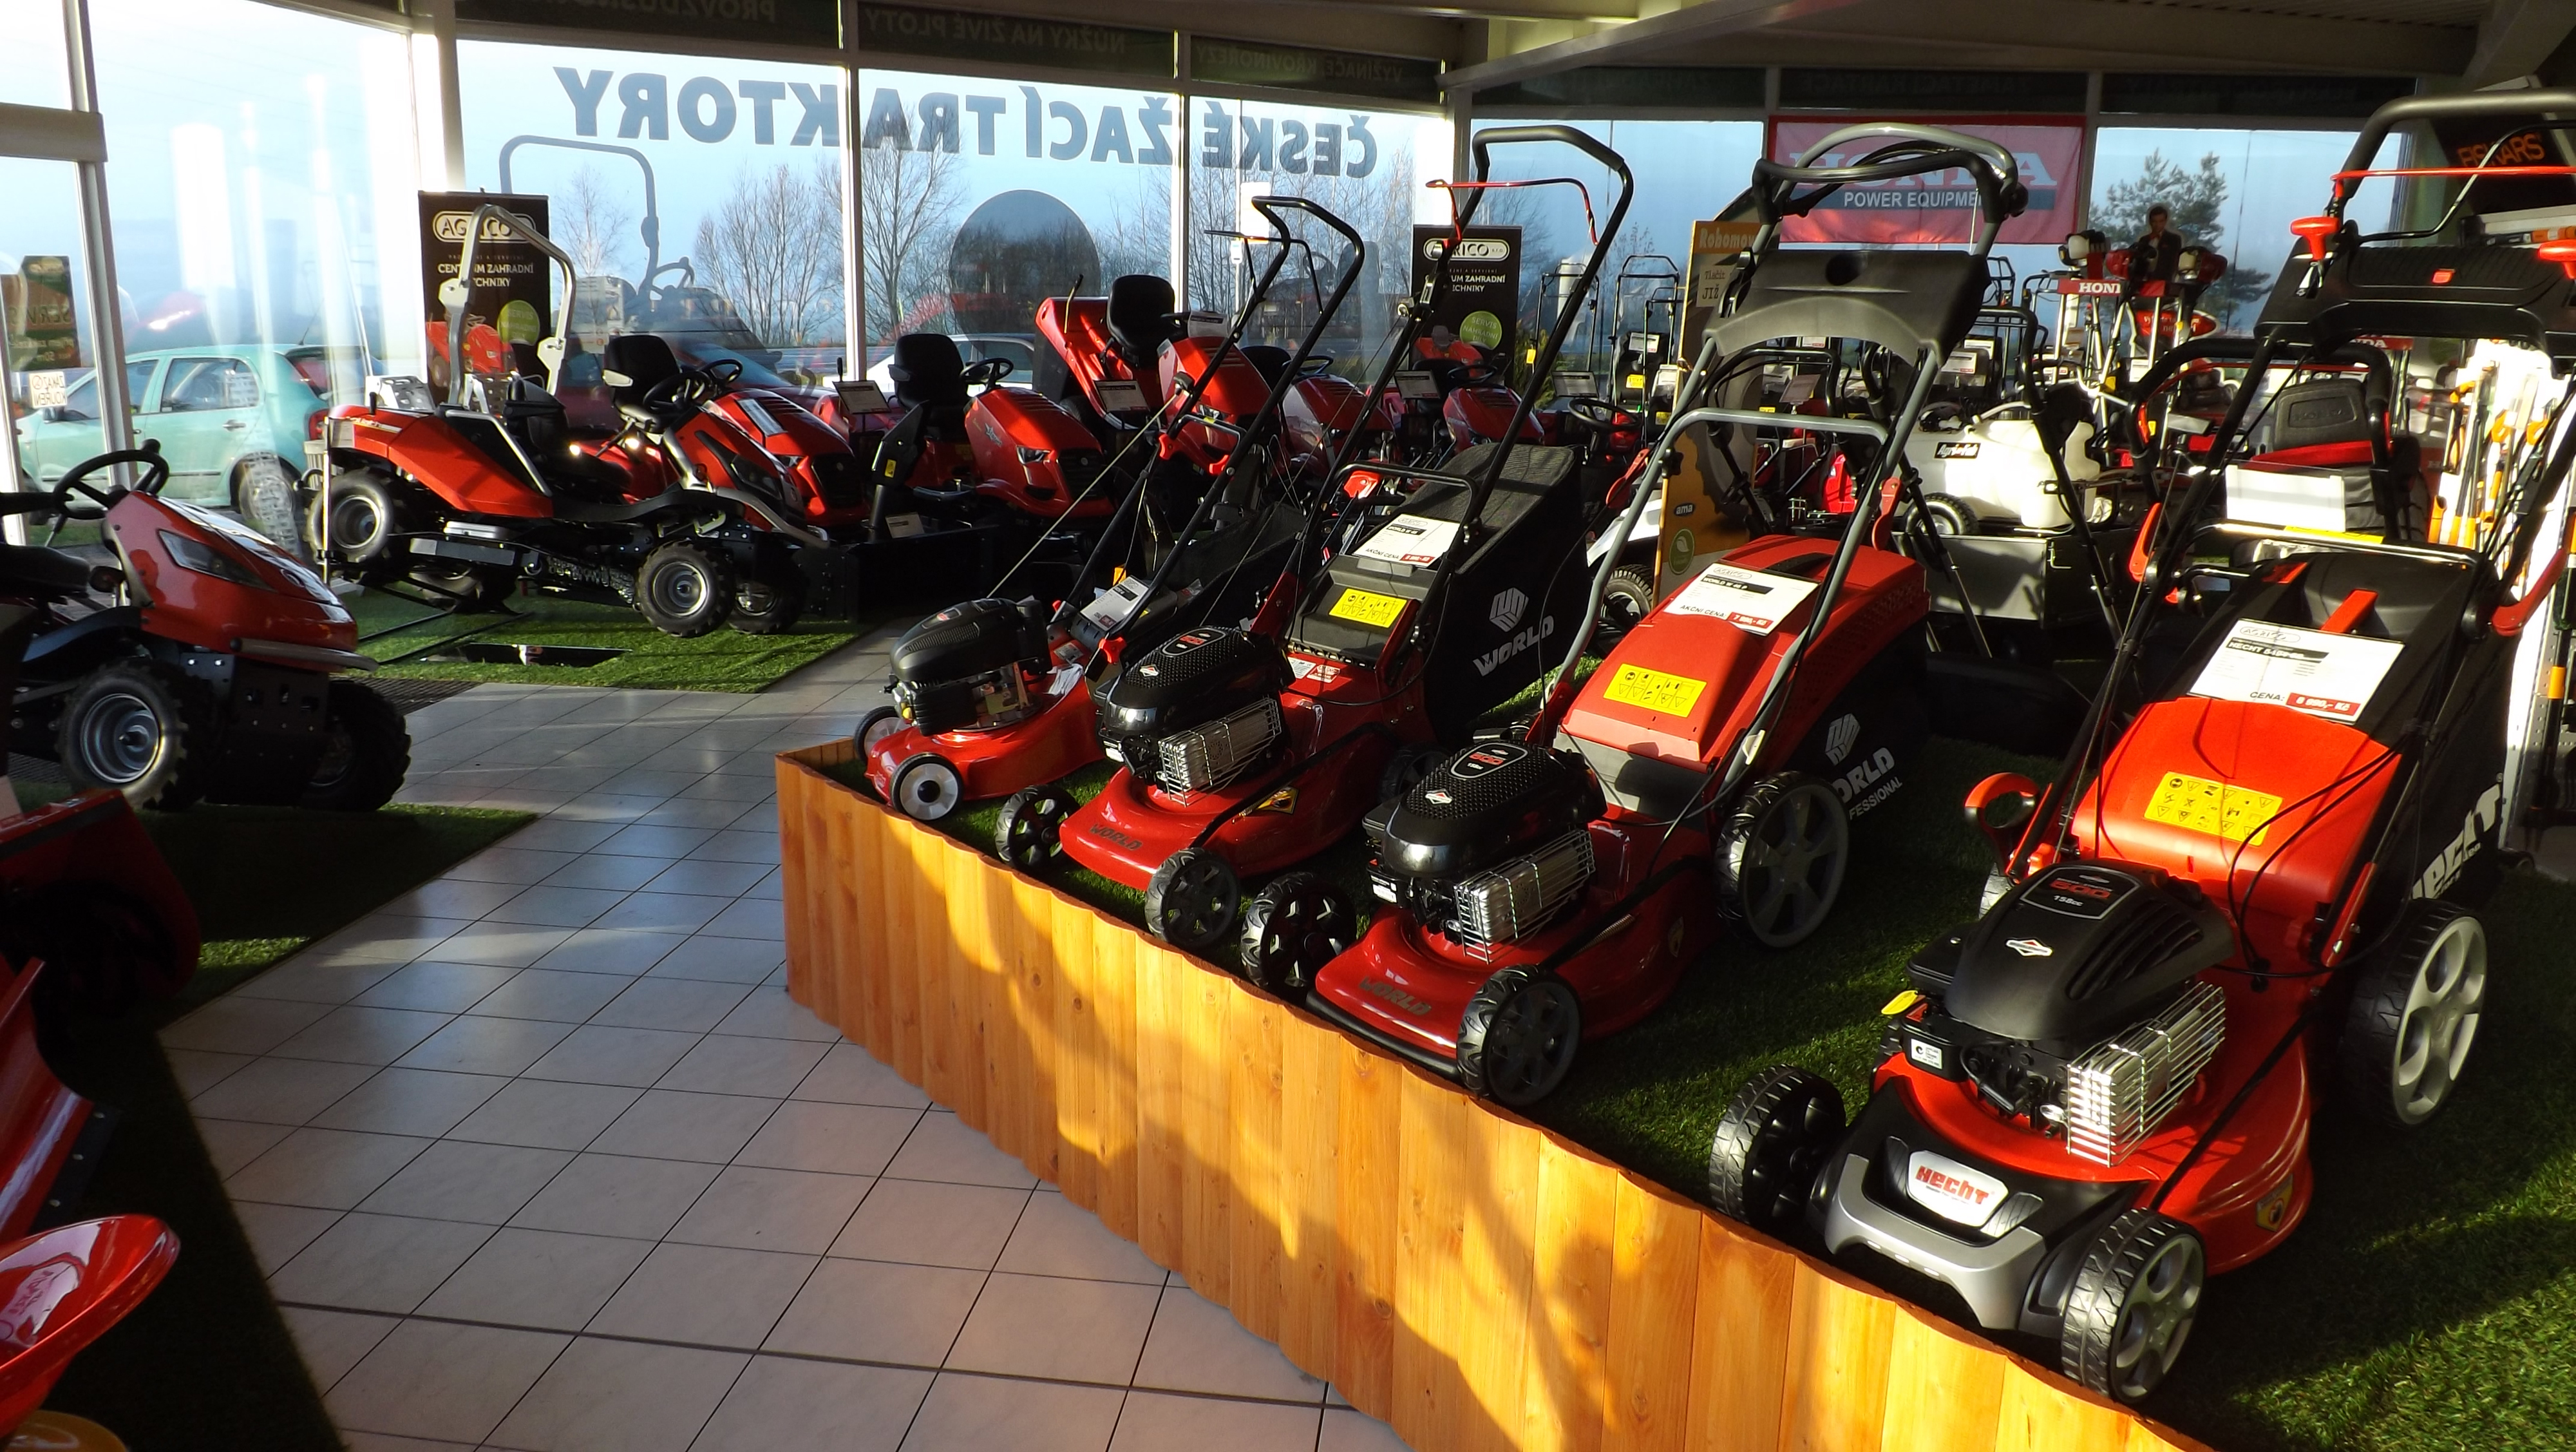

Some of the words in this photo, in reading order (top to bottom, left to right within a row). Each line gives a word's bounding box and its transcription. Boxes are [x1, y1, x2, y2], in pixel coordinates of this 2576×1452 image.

[1844, 191, 1902, 207] POWER
[488, 262, 534, 274] ZAHRADNÍ
[1464, 274, 1506, 283] ZAHRADNÍ
[1472, 316, 1497, 329] SERVIS
[1676, 504, 1693, 515] ama
[1679, 603, 1704, 613] AKČNÍ
[1704, 609, 1727, 618] CENA:
[1472, 615, 1554, 677] WORLD
[2228, 641, 2264, 653] HECHT
[2249, 691, 2286, 701] CENA:
[1832, 747, 1895, 803] ORLD
[1849, 776, 1903, 820] FESSIONAL
[2054, 895, 2084, 906] 158cc
